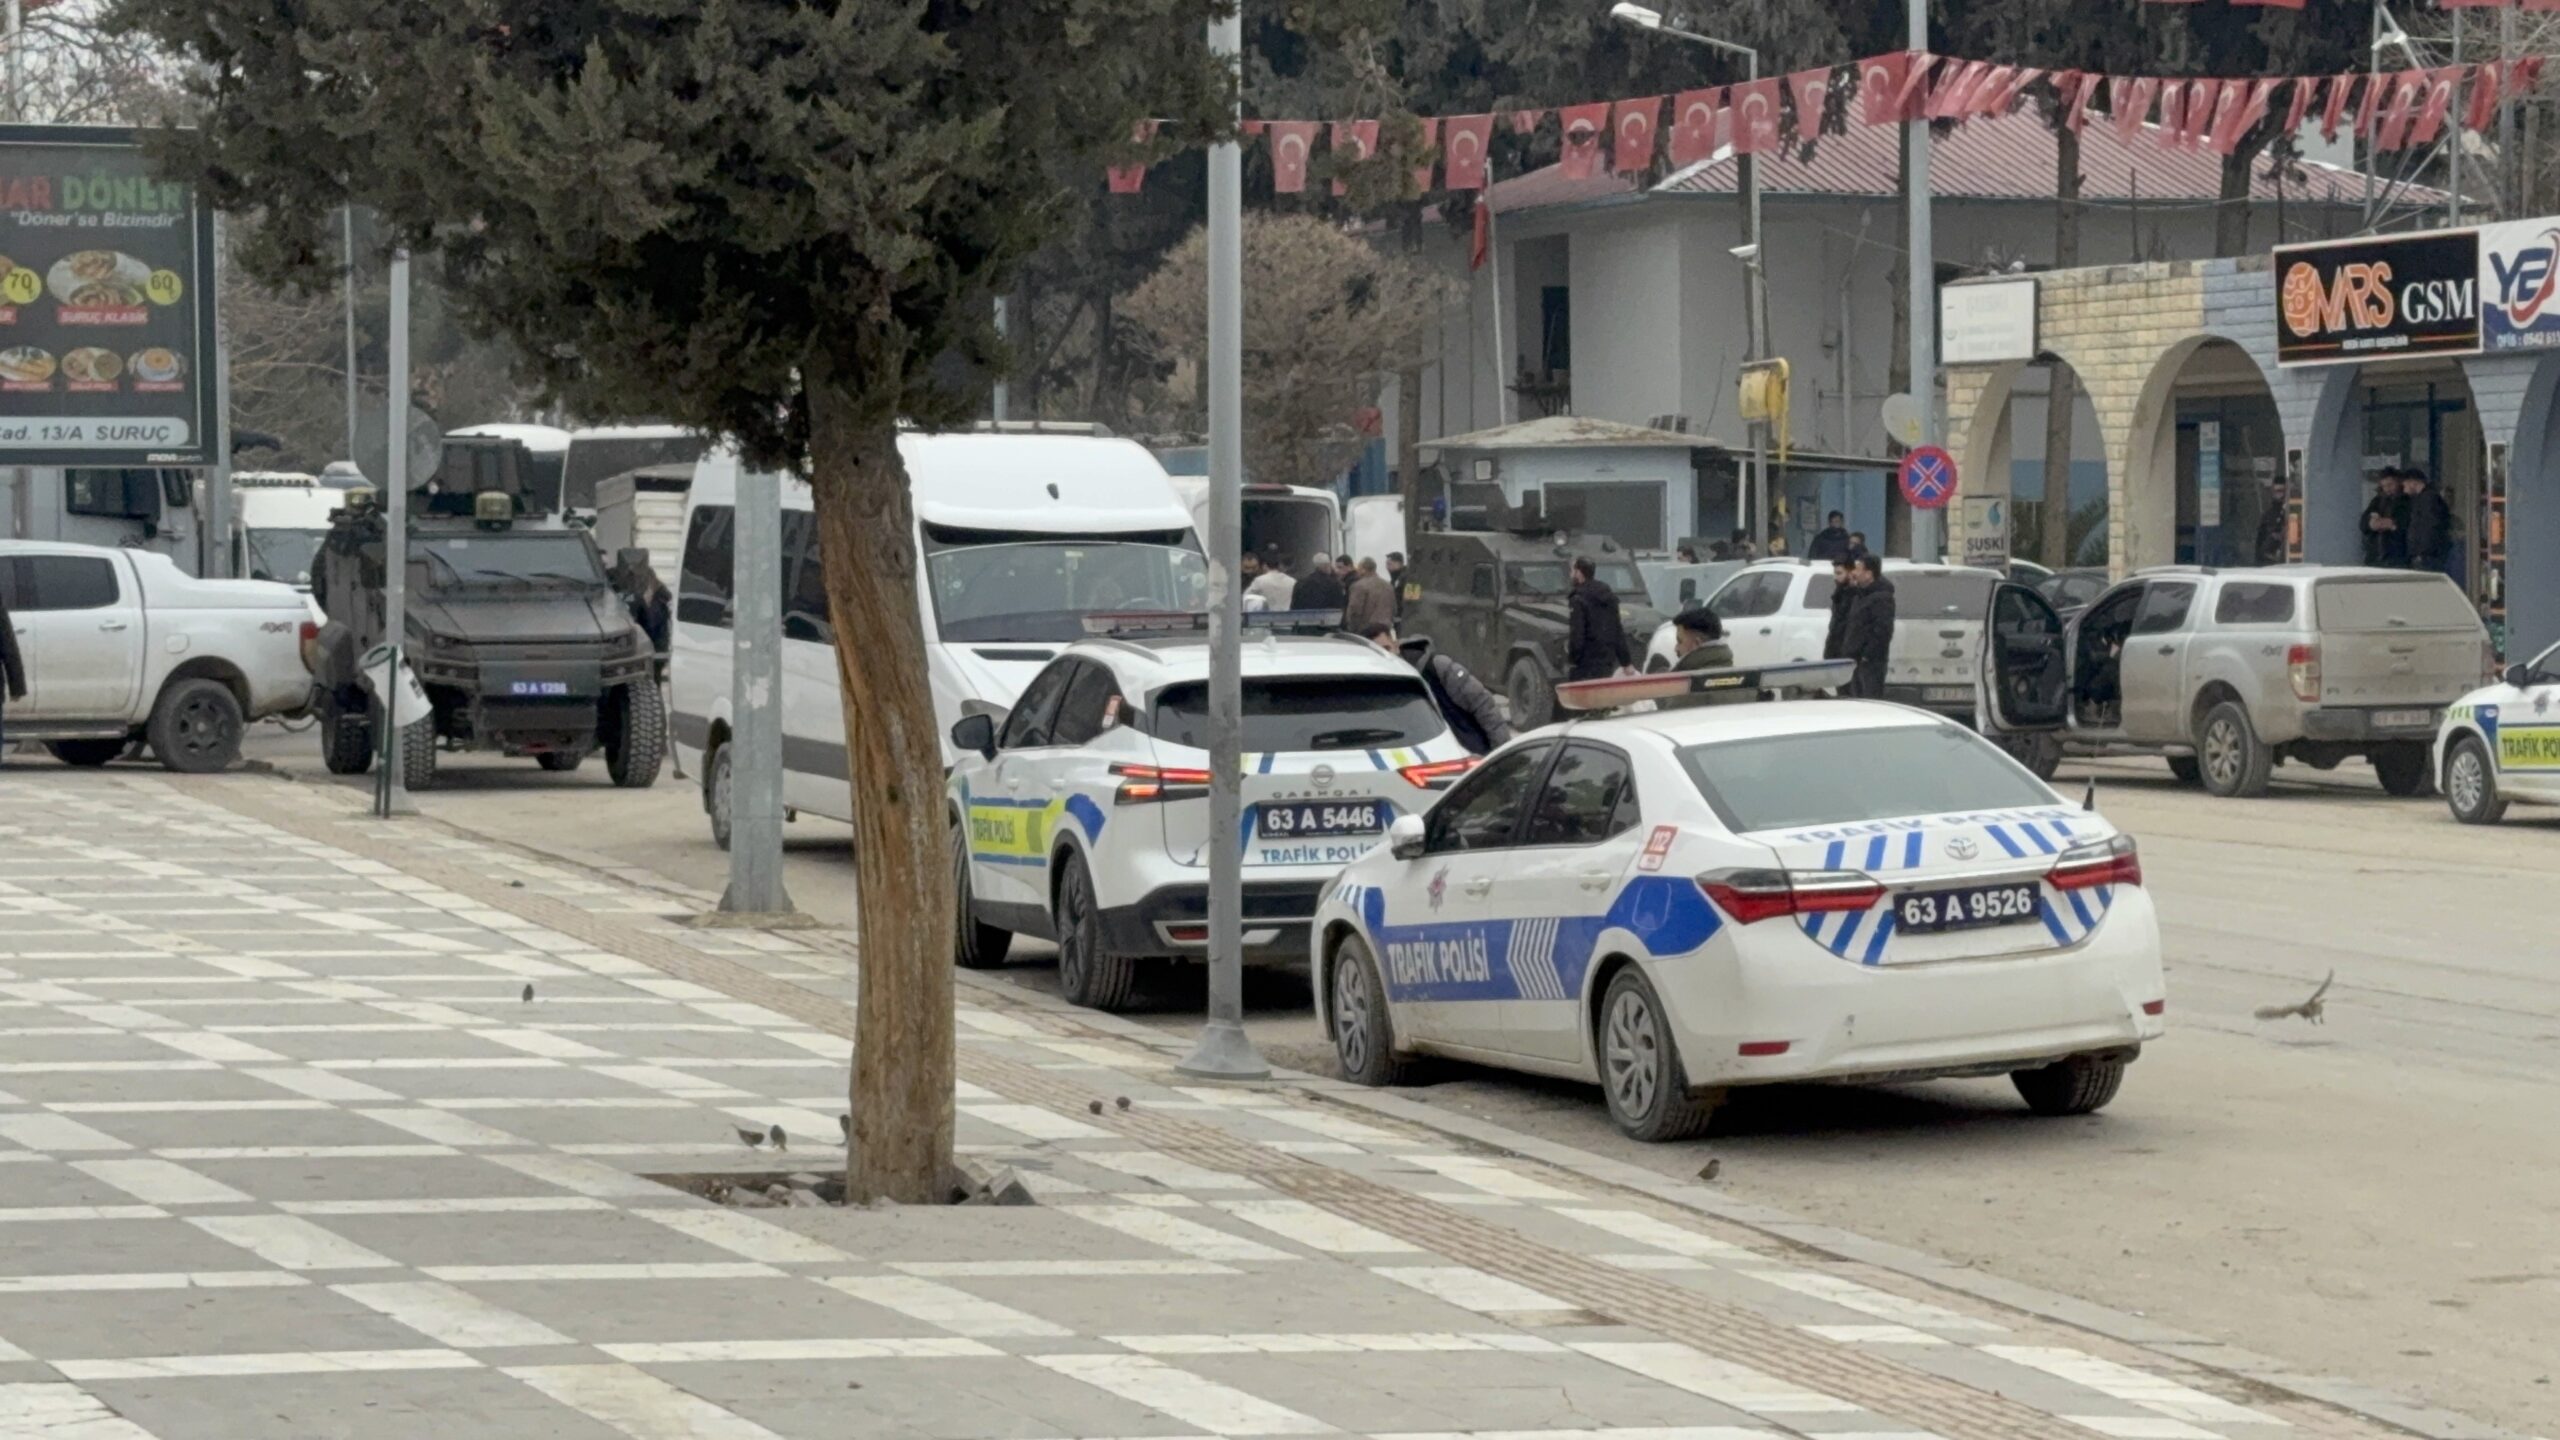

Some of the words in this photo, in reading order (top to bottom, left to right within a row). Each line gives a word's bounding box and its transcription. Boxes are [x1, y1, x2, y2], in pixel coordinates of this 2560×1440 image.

[0, 176, 51, 209] AR
[2401, 278, 2475, 324] GSM
[0, 425, 32, 440] ad.
[41, 425, 83, 440] 13/A
[95, 425, 169, 444] SURUÇ
[1267, 808, 1295, 830] 63
[1301, 808, 1317, 830] A
[1322, 806, 1375, 828] 5446
[1260, 844, 1320, 862] TRAFİK
[1904, 900, 1937, 925] 63
[1945, 896, 1964, 921] A
[1970, 888, 2032, 917] 9526
[1387, 931, 1440, 985] TRAFİK
[1439, 928, 1491, 983] POLİSİ
